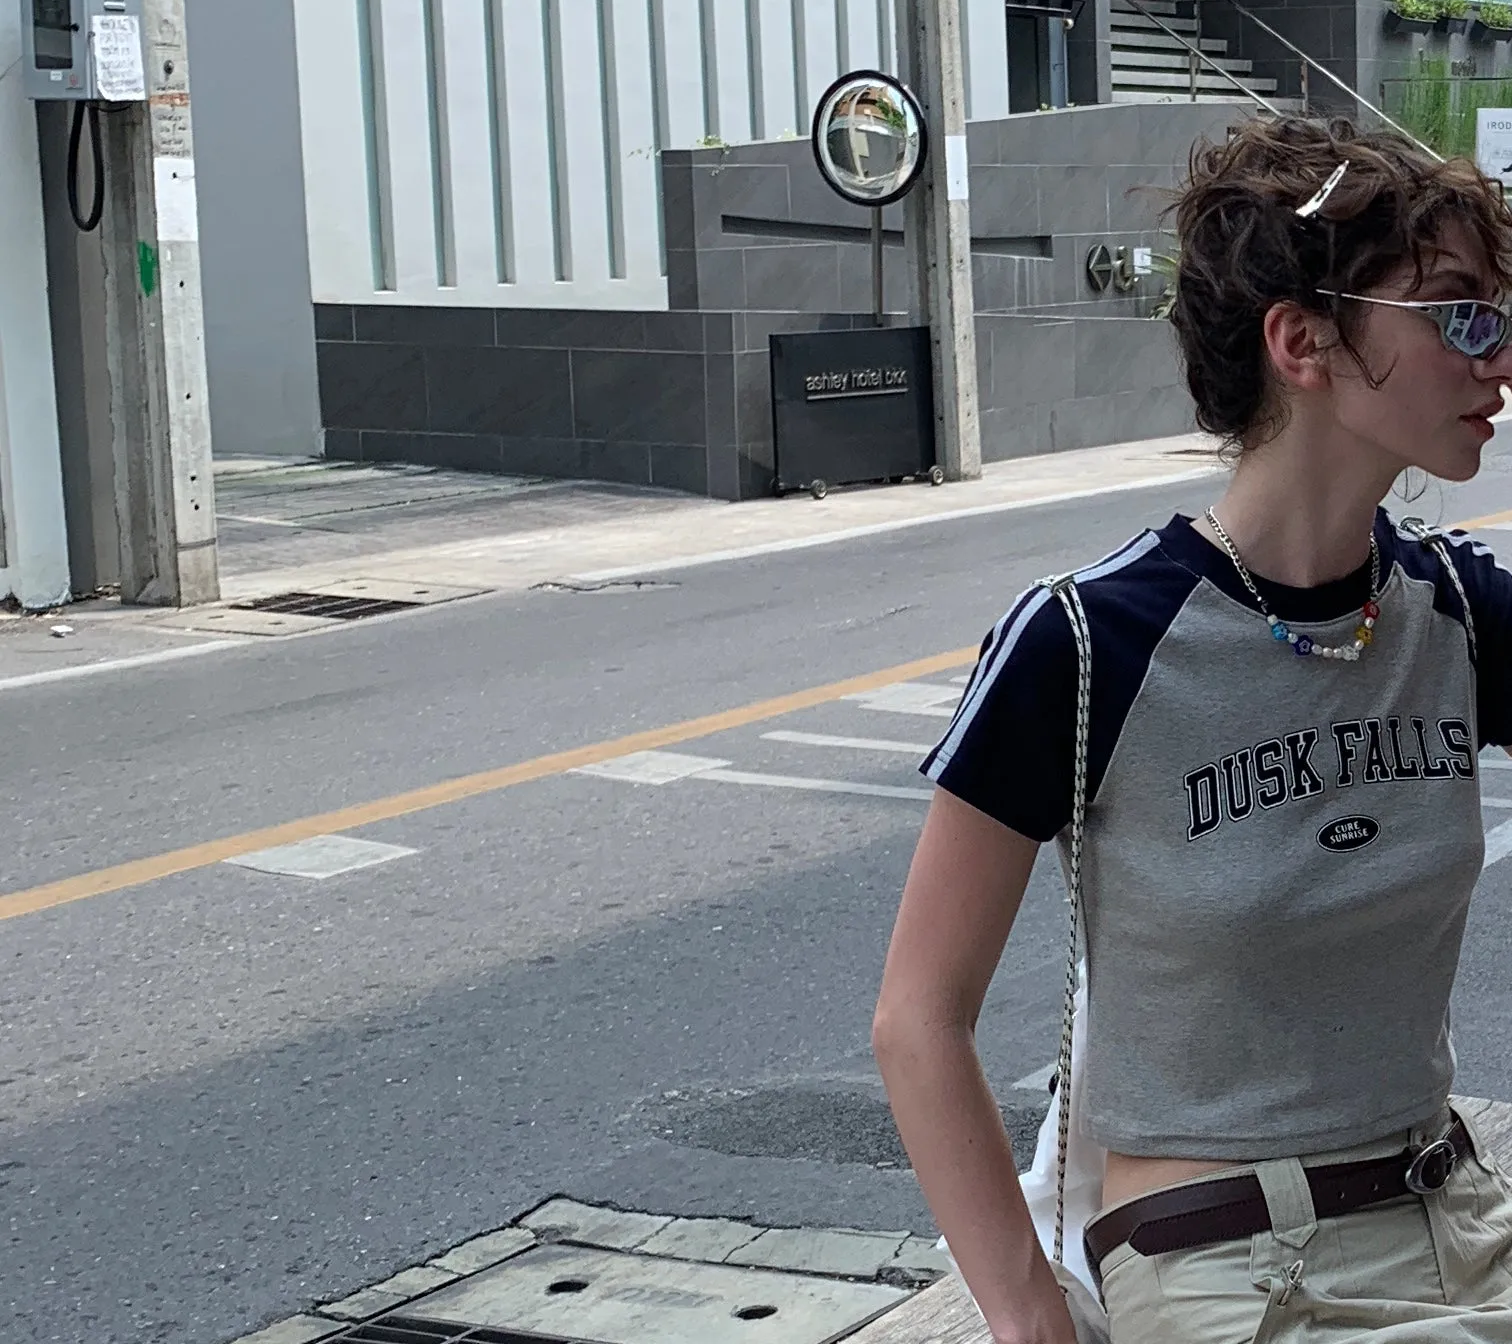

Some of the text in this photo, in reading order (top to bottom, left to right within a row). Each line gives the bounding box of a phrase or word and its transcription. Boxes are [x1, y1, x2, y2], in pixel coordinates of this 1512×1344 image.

[805, 371, 848, 391] ashley
[851, 368, 882, 388] hotel
[1183, 716, 1477, 842] DUSK FALLS
[1329, 828, 1369, 845] SUNRISE
[1334, 821, 1361, 834] CURE
